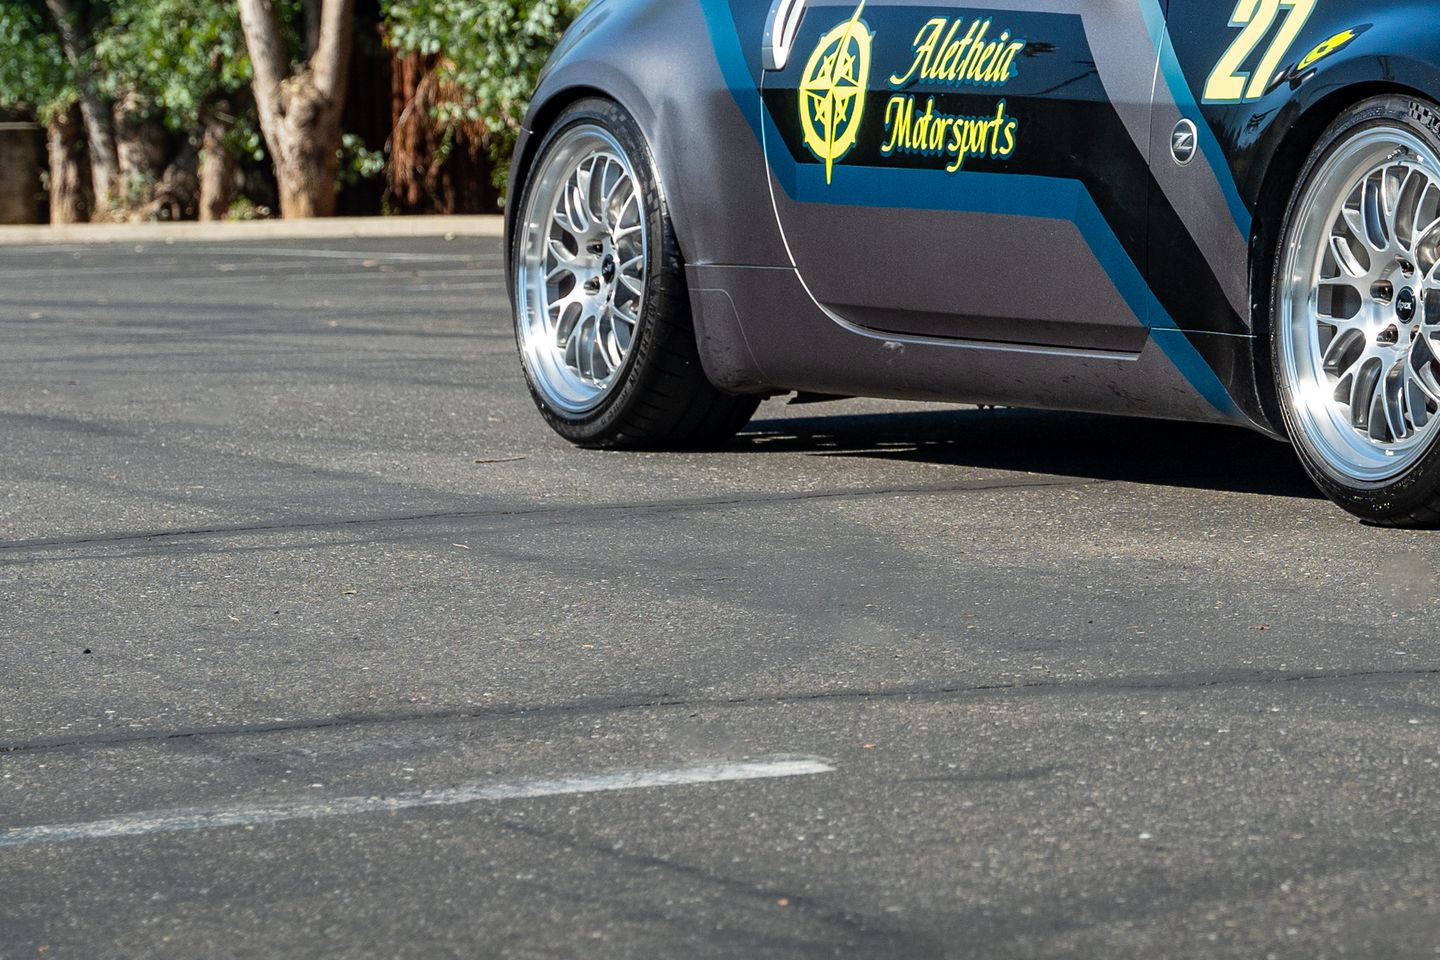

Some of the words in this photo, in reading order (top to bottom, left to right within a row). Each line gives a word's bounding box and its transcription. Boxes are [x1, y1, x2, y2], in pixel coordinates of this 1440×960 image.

[889, 18, 1024, 85] Aletheia
[881, 96, 1017, 173] Motorsports
[1173, 132, 1193, 151] Z
